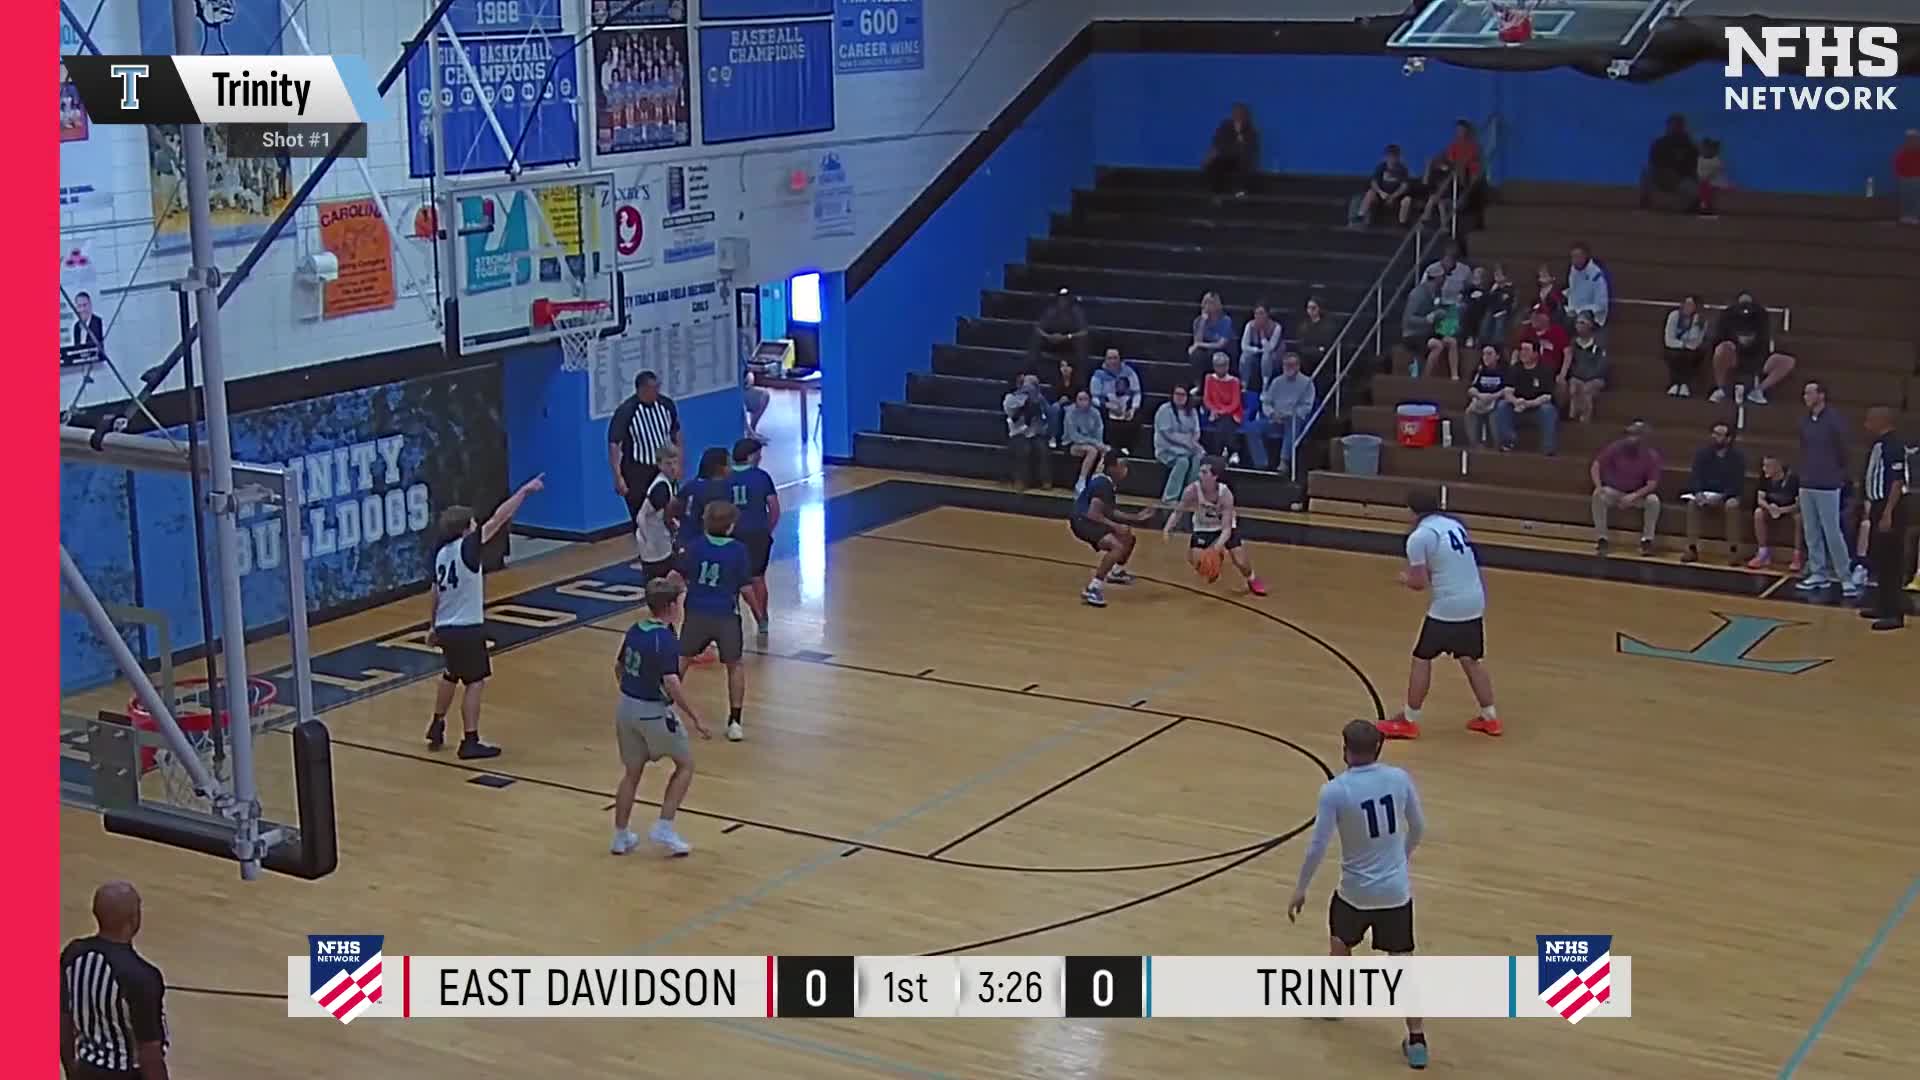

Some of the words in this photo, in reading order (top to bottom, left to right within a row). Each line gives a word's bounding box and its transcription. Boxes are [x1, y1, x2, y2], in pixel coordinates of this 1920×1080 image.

[477, 1, 520, 24] 1988
[860, 8, 898, 35] 600
[731, 27, 804, 46] BASEBALL
[480, 43, 552, 63] BASKETBALL
[729, 44, 805, 64] CHAMPIONS
[839, 42, 887, 59] CAREER
[891, 40, 919, 55] WINS
[445, 62, 546, 85] CHMPIONS
[732, 485, 748, 505] 11
[437, 560, 459, 592] 24
[699, 560, 721, 588] 14
[1360, 793, 1397, 839] 11
